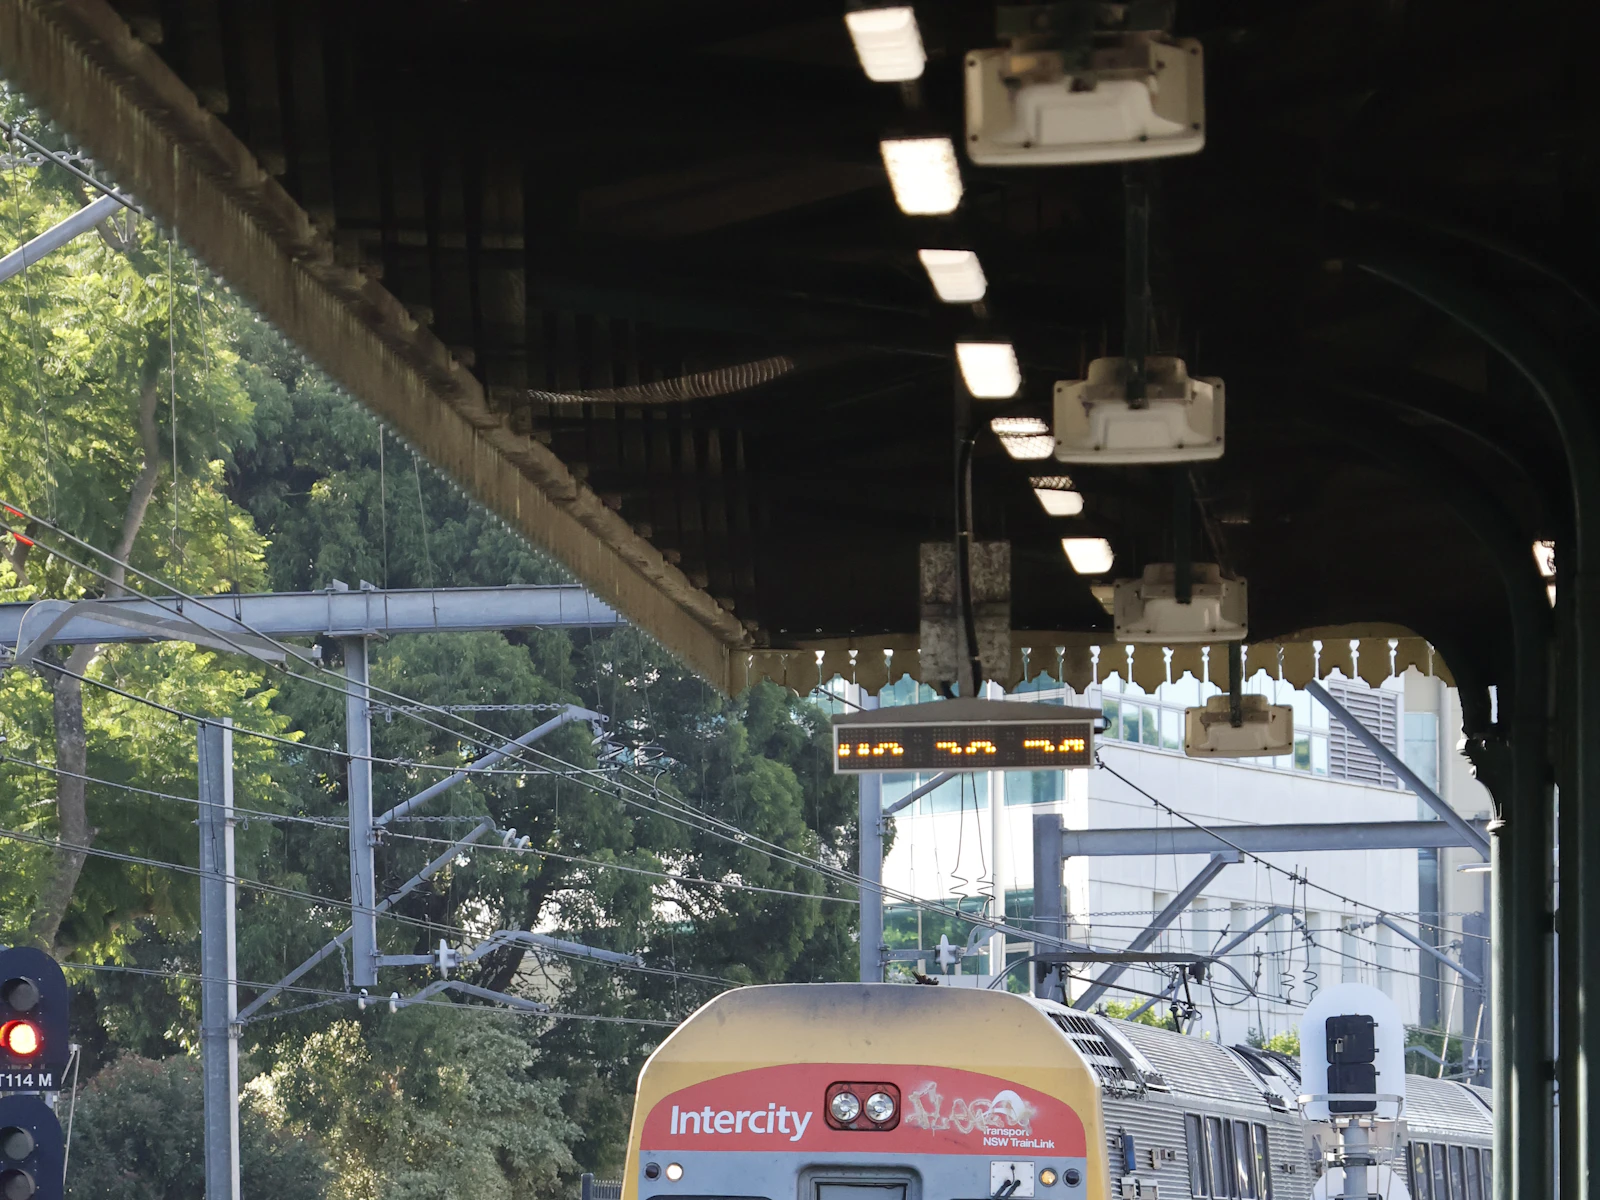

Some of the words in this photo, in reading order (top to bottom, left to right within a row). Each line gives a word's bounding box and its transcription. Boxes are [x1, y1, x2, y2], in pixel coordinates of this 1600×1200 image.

[38, 1073, 52, 1087] M
[670, 1102, 813, 1142] Intercity
[983, 1126, 1030, 1139] Transport
[983, 1137, 1009, 1147] NSW
[1010, 1138, 1055, 1149] TrainLink
